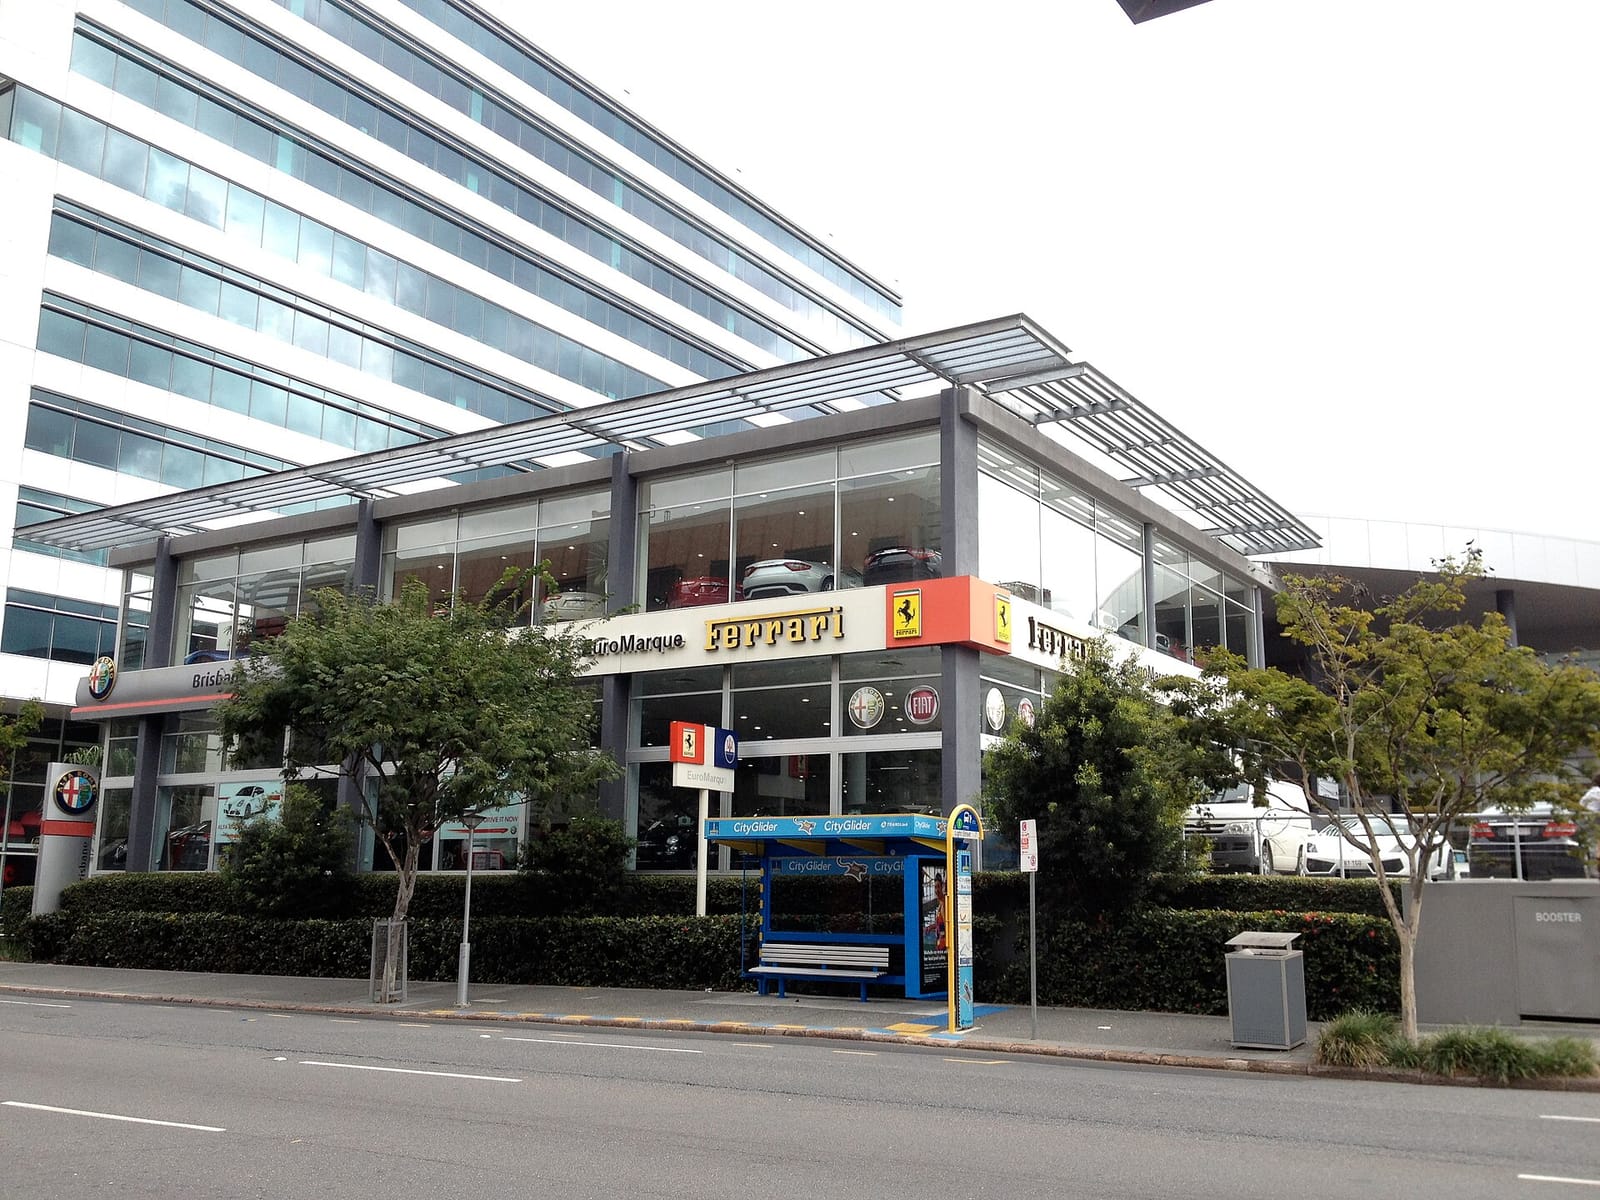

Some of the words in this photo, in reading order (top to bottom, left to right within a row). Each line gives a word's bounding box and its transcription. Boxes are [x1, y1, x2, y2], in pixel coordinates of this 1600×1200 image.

[704, 605, 843, 652] Ferrari
[912, 696, 933, 714] FIAT
[733, 821, 778, 835] CityGlider
[824, 820, 872, 834] CityGlider
[788, 861, 831, 873] CityGlider
[874, 861, 905, 874] CityGl
[1535, 912, 1582, 922] BOOSTER
